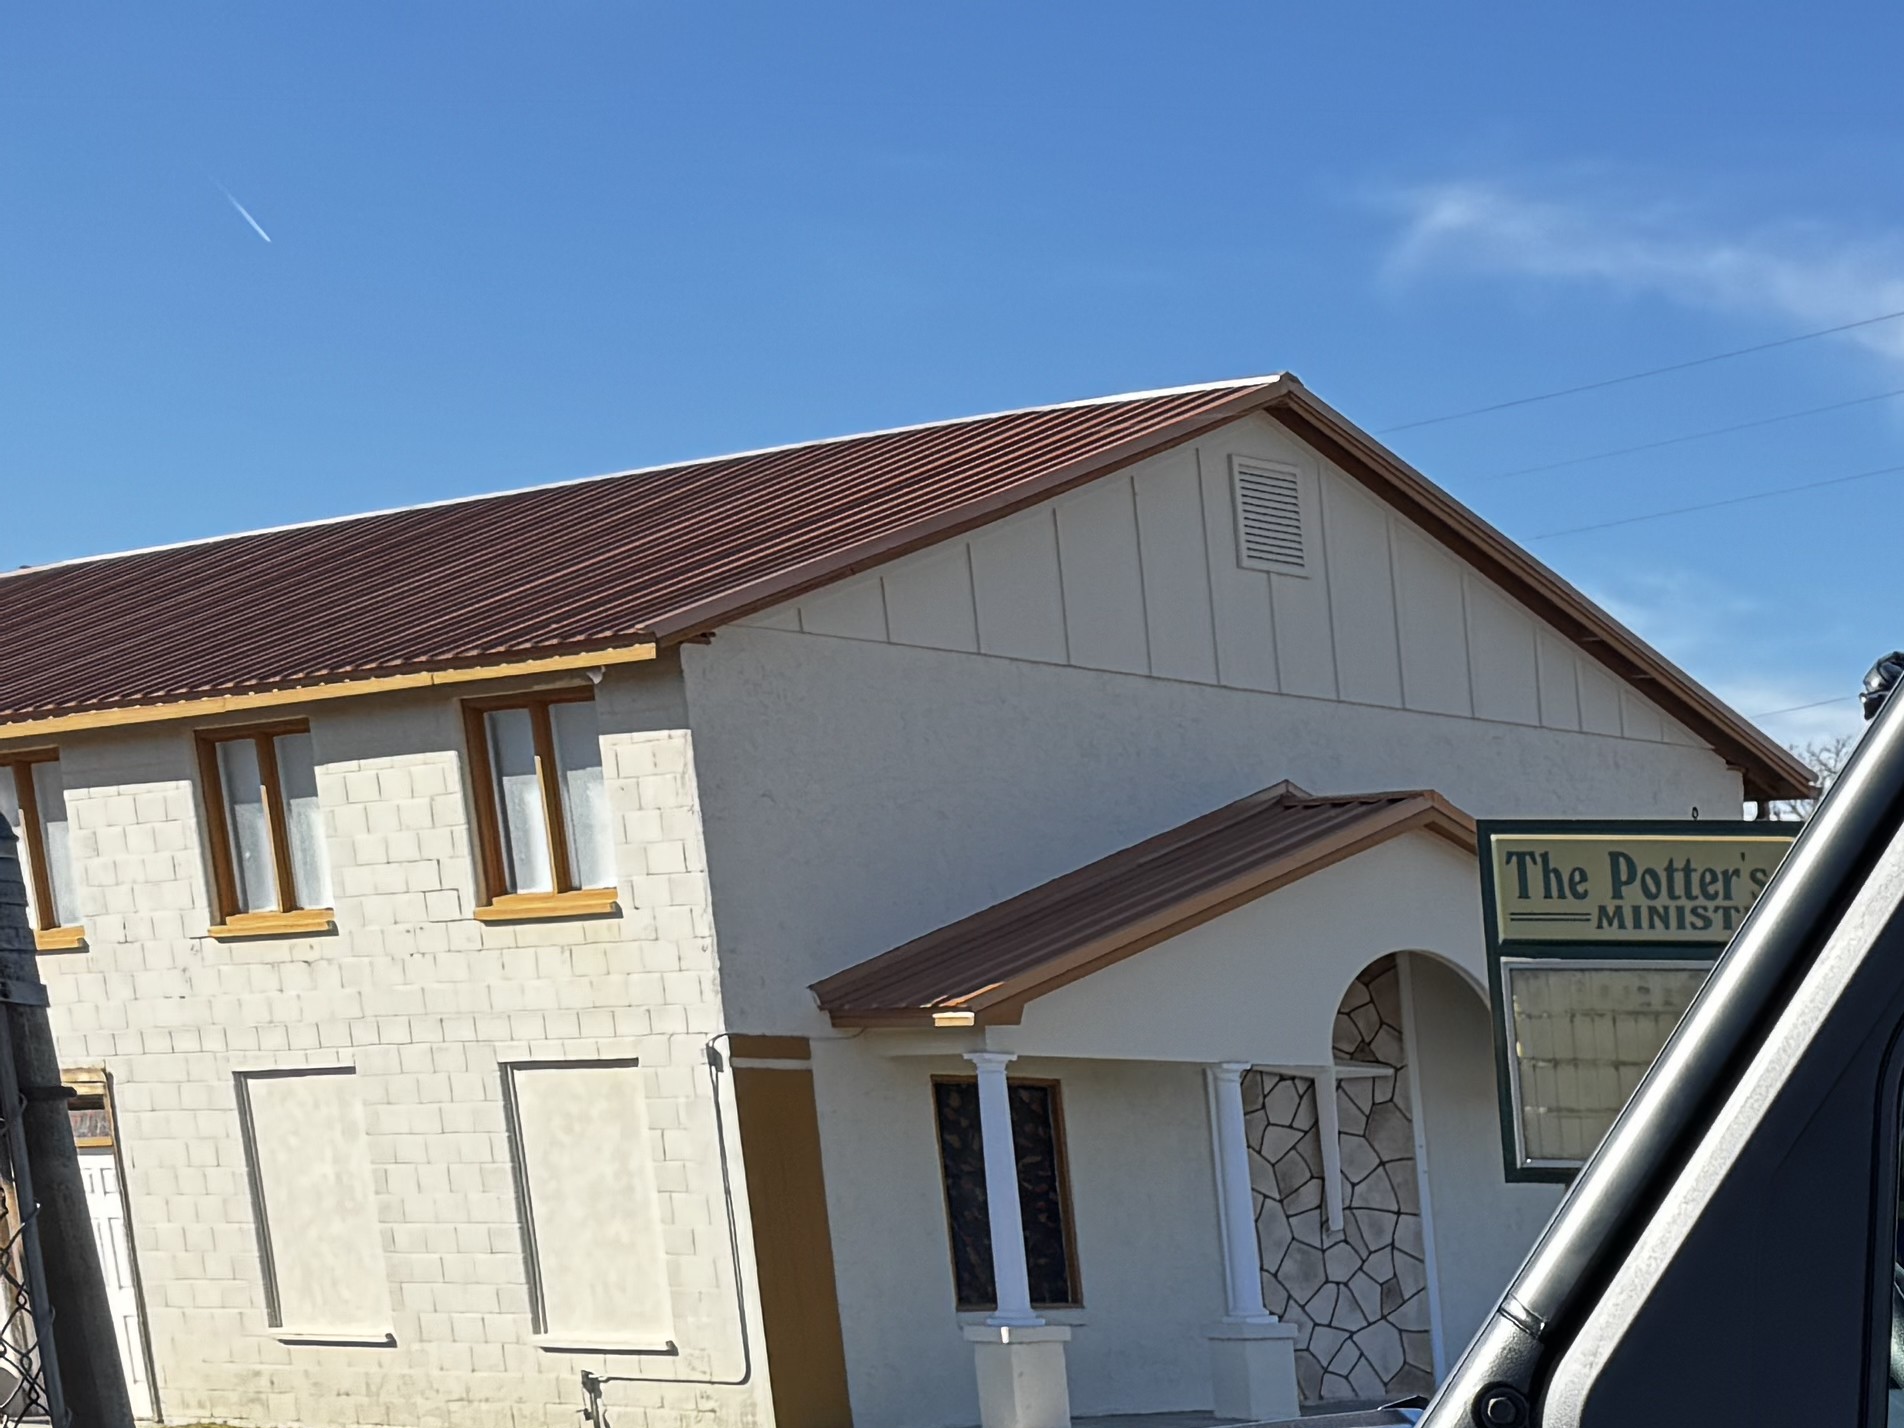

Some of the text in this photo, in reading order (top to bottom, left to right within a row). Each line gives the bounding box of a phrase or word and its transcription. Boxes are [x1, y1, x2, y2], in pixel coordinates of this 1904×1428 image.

[1505, 850, 1770, 901] The Potter's
[1595, 903, 1750, 931] MINIST
